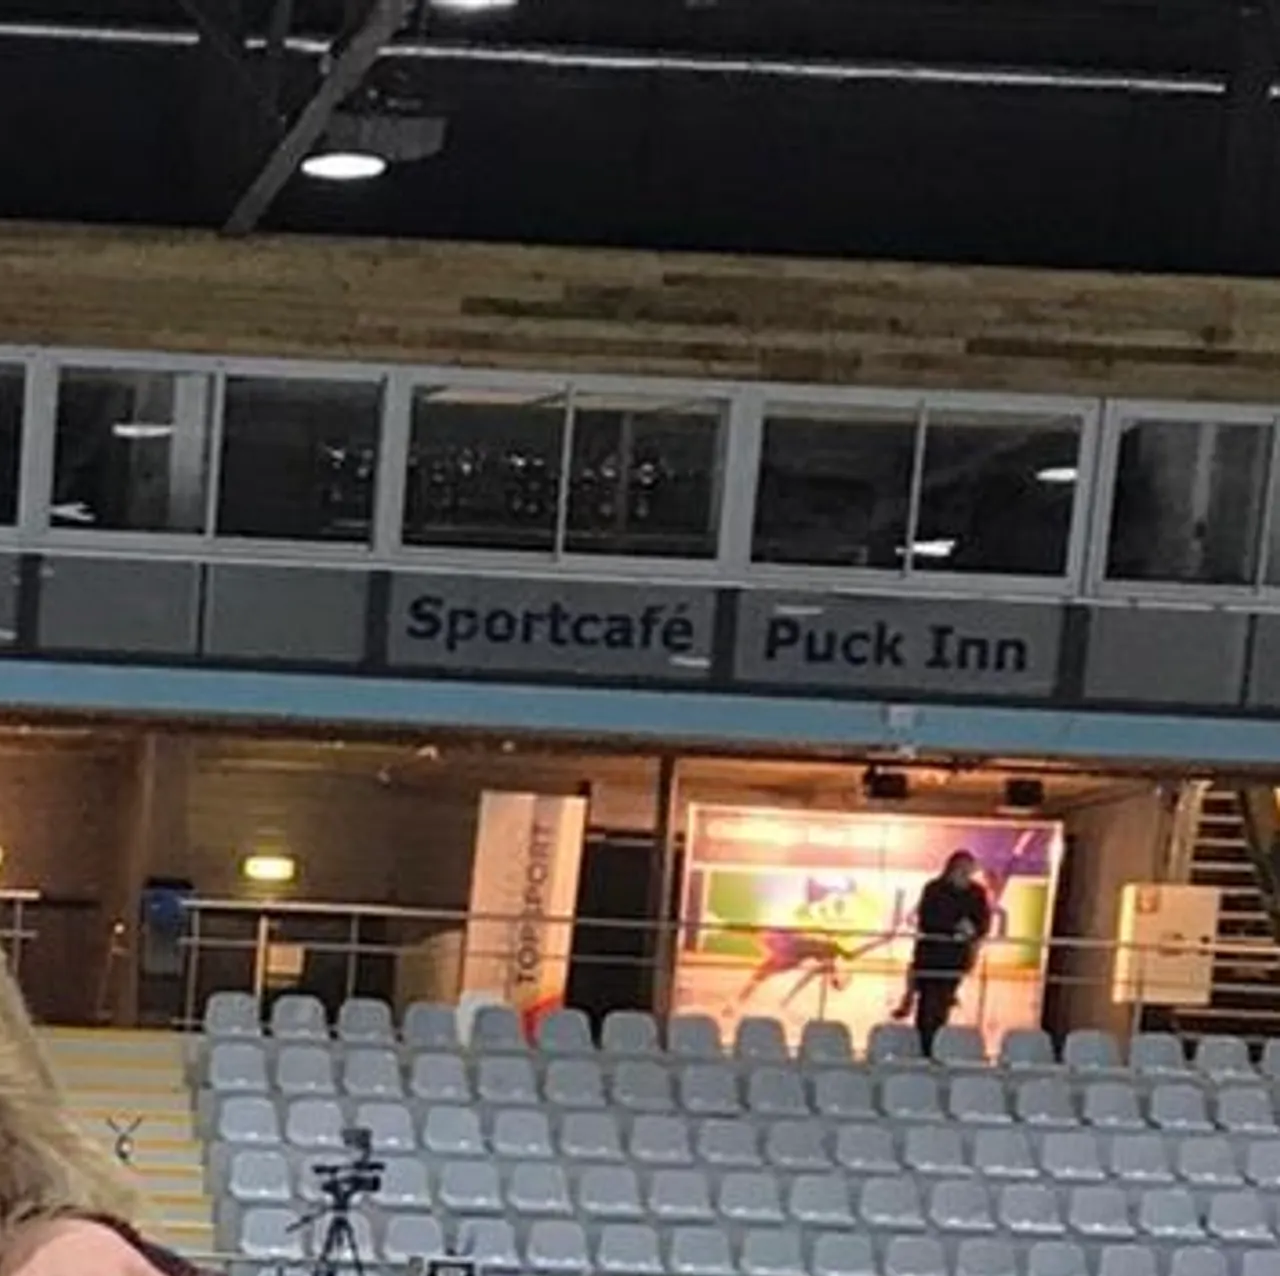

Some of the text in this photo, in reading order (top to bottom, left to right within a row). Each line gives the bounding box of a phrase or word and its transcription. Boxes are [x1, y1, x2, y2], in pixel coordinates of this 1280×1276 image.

[406, 595, 694, 653] Sportcafé
[765, 616, 1027, 672] Puck Inn
